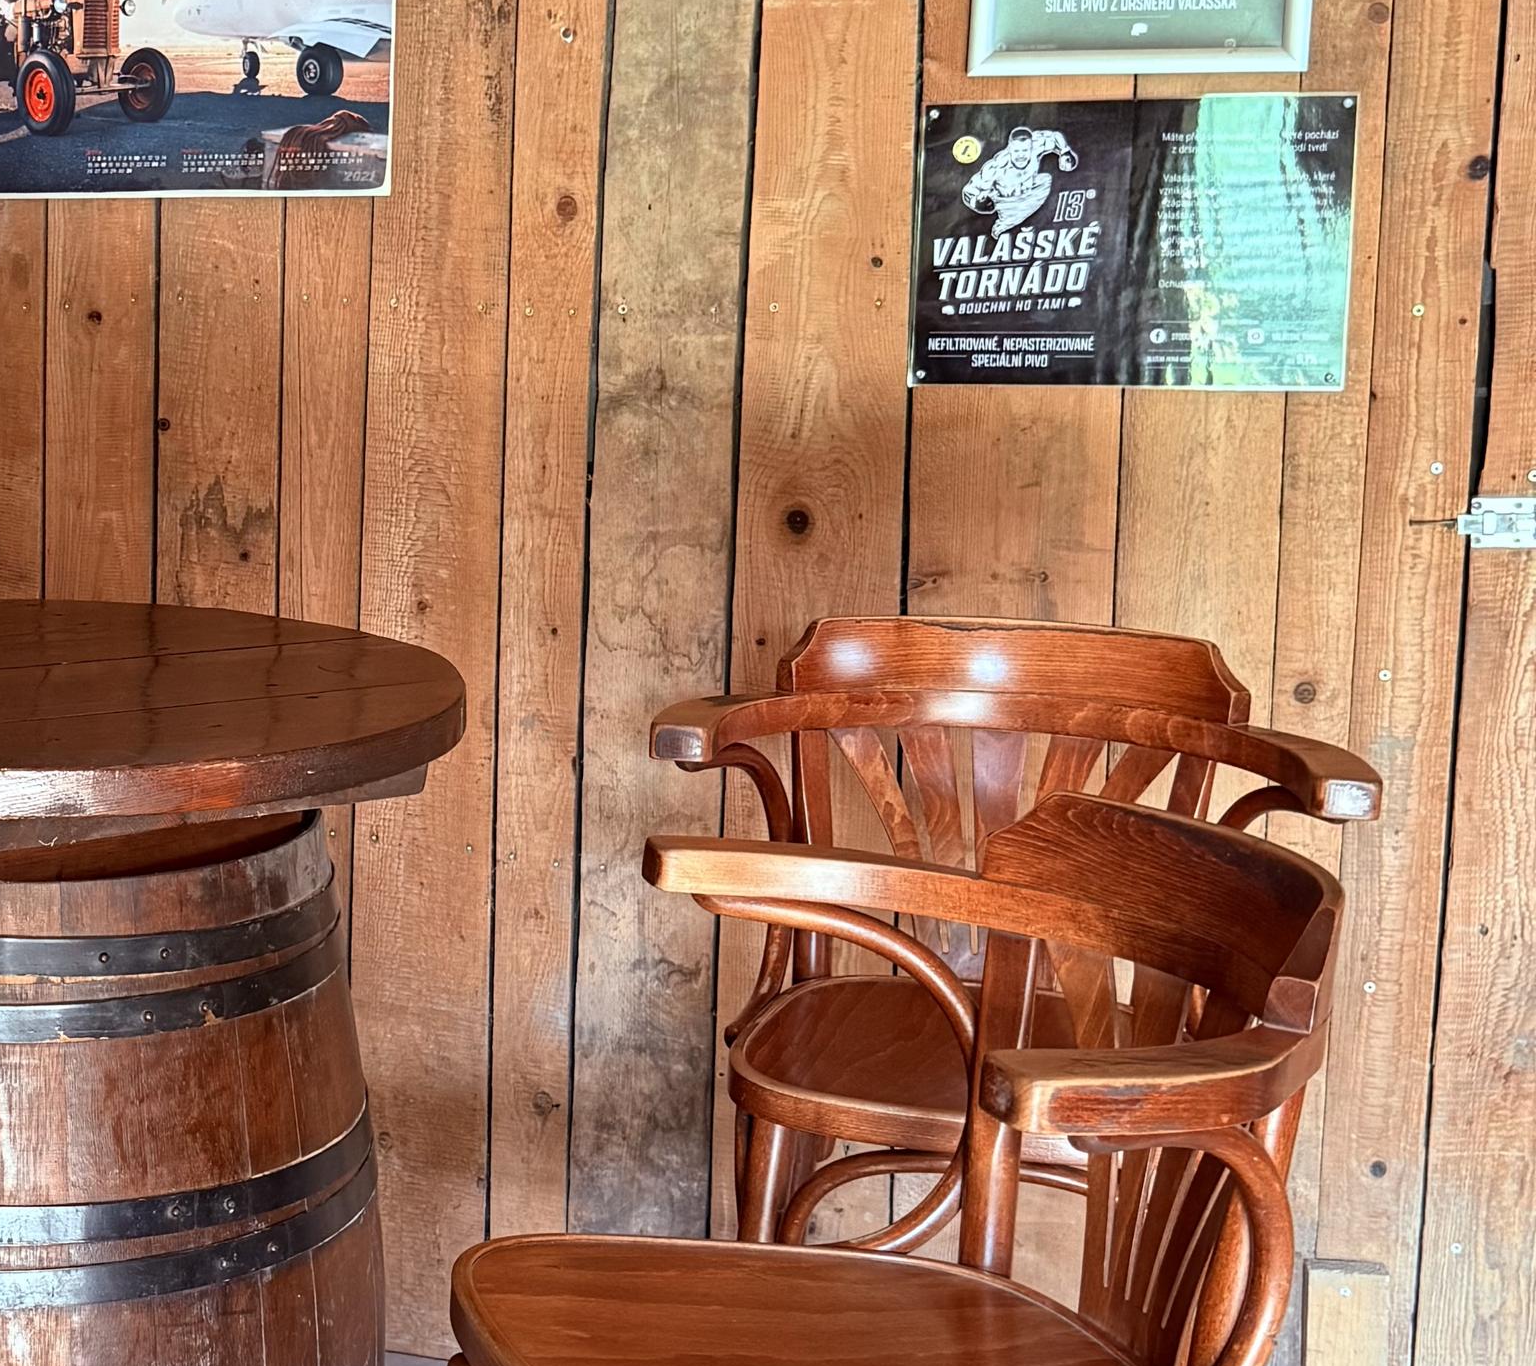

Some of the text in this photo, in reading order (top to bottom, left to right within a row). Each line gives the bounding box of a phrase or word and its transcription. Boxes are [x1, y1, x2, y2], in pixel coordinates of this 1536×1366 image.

[933, 221, 1101, 267] VALAŠSKÉ
[939, 261, 1090, 300] TORNÁDO
[958, 301, 1010, 315] BOUCHNI
[1016, 299, 1031, 312] HO
[1003, 336, 1094, 352] NEPASTERIZOVANÉ
[971, 353, 1048, 368] SPECIÁLNÍ PIVO
